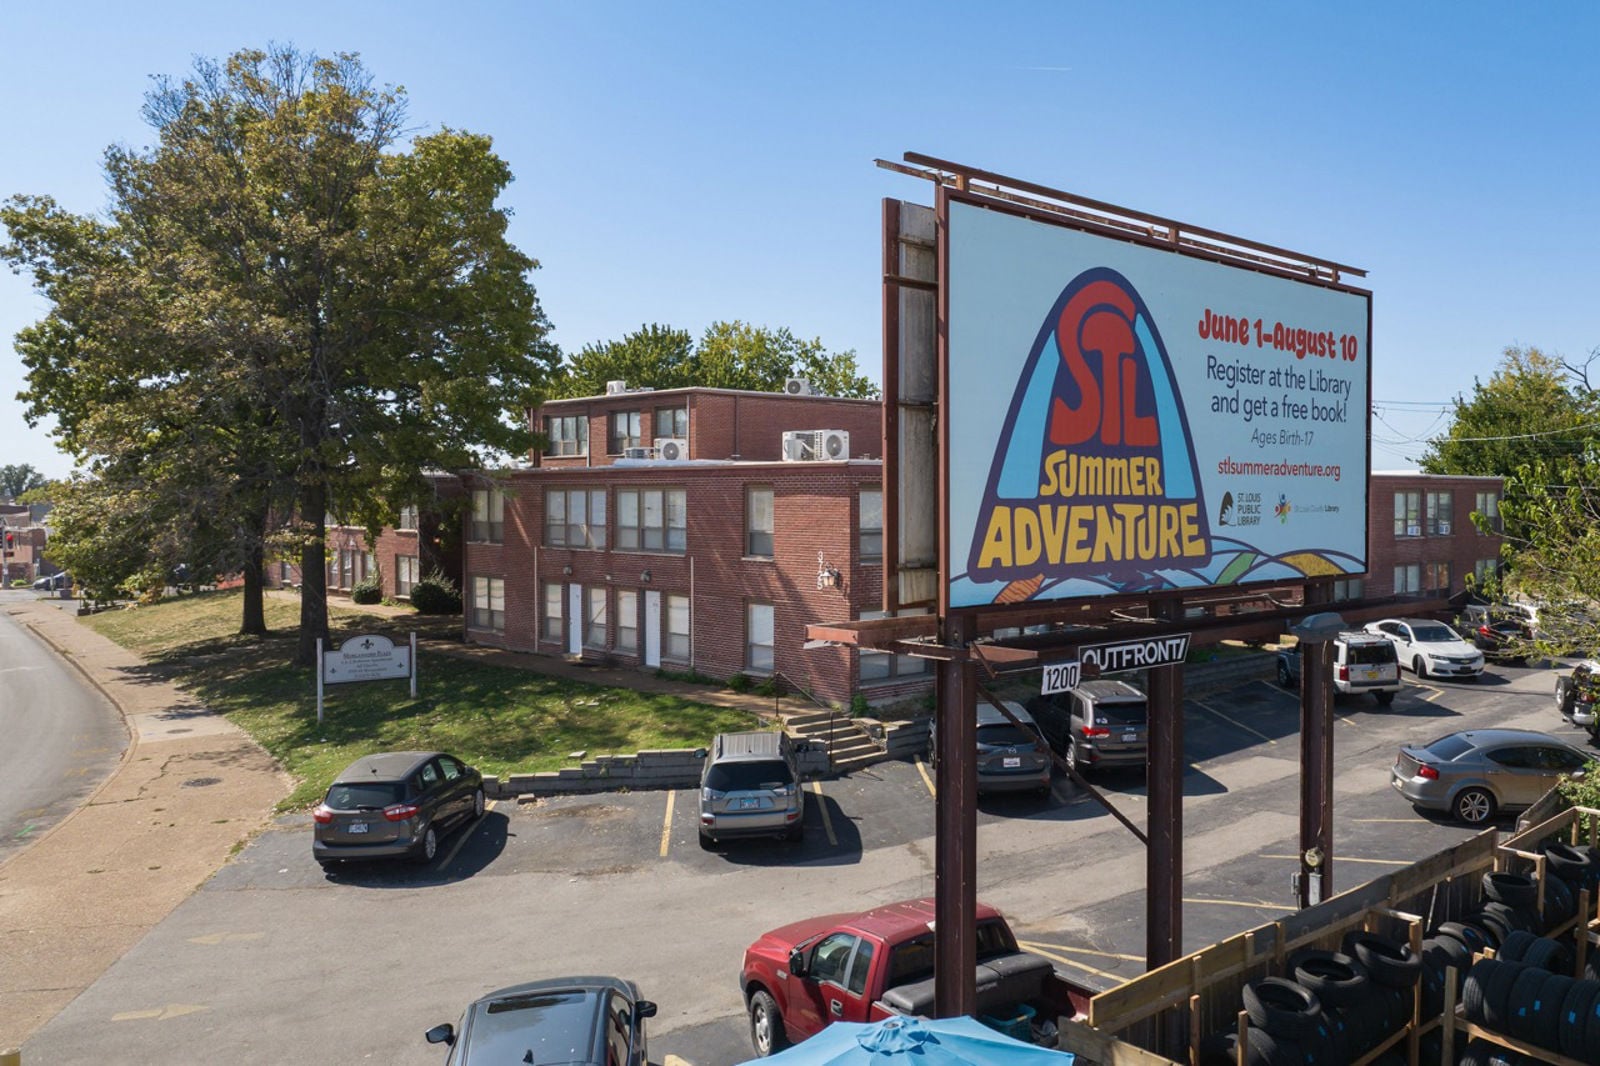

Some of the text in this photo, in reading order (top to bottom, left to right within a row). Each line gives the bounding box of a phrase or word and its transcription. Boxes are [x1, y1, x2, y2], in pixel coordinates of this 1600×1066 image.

[1198, 308, 1250, 346] June
[1339, 334, 1358, 362] 10
[1050, 280, 1159, 447] STL
[1207, 354, 1352, 401] Register at the Library
[1211, 389, 1347, 423] and get a free book!
[1251, 427, 1314, 448] Ages Birth-17
[1039, 449, 1163, 498] SUMMER
[1218, 456, 1341, 482] stlsummeradventure.org
[1237, 504, 1261, 515] PUBLIC
[1245, 492, 1261, 503] LOUIS
[977, 502, 1206, 569] ADVENTURE
[1237, 516, 1261, 527] LIBRARY
[1046, 665, 1078, 691] 1200
